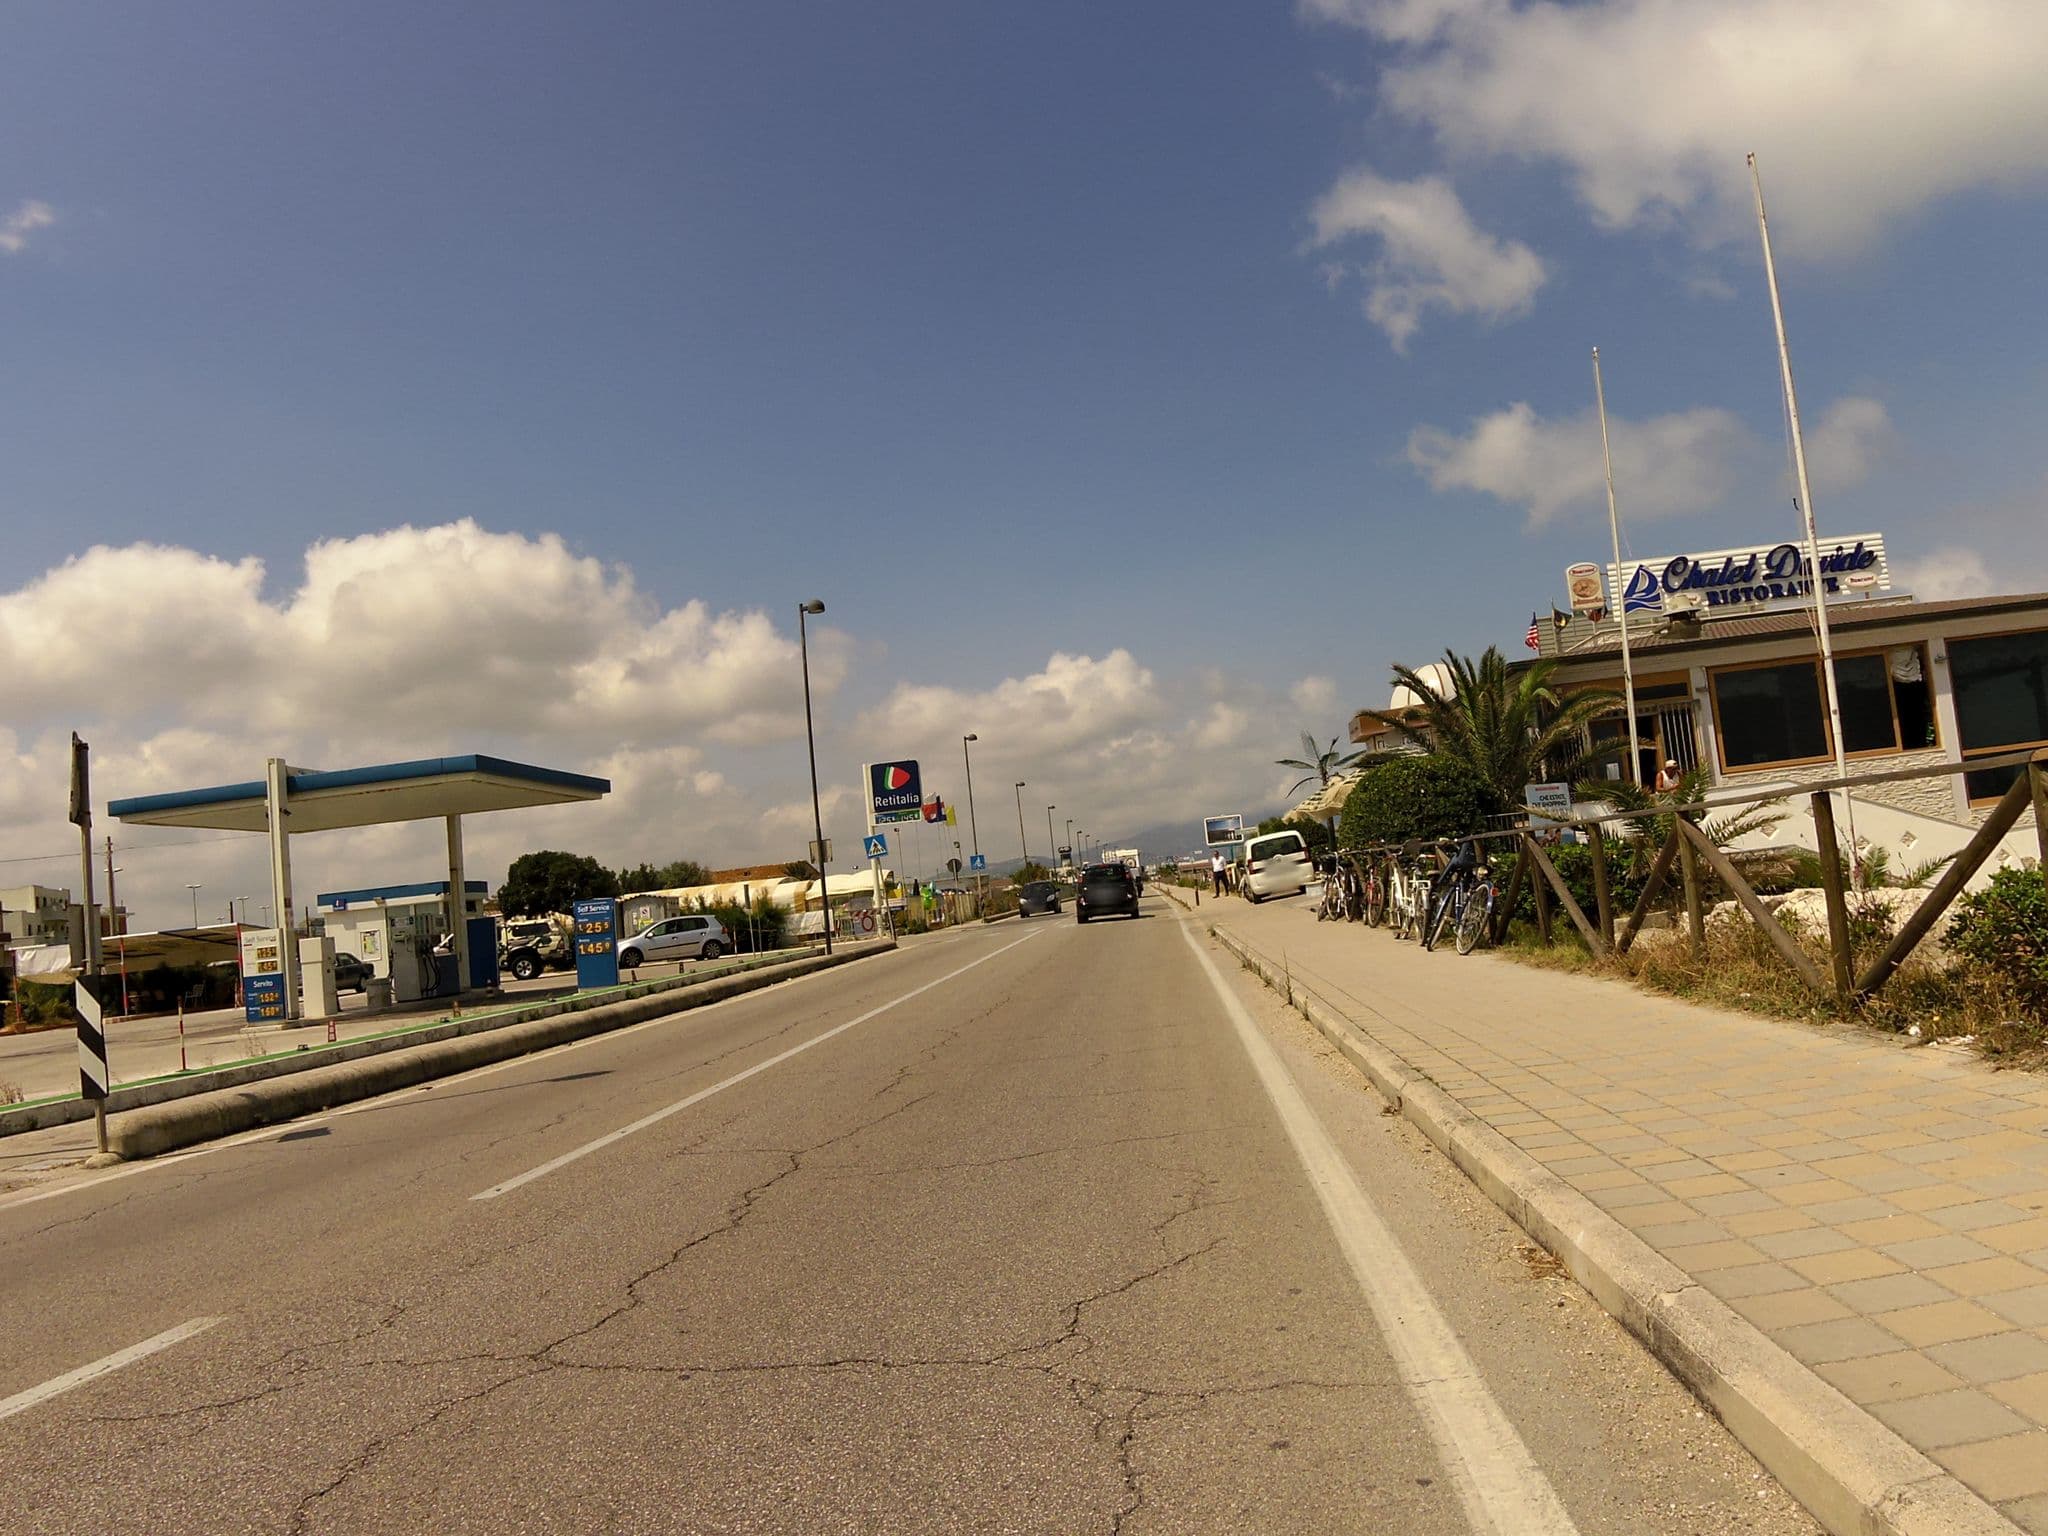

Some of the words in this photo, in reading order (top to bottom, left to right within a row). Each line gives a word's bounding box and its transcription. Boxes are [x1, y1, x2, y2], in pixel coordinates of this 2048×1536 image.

[1661, 556, 1757, 593] Chalet
[1763, 542, 1878, 580] Davide
[875, 794, 919, 807] Retitalia
[589, 904, 610, 912] Service
